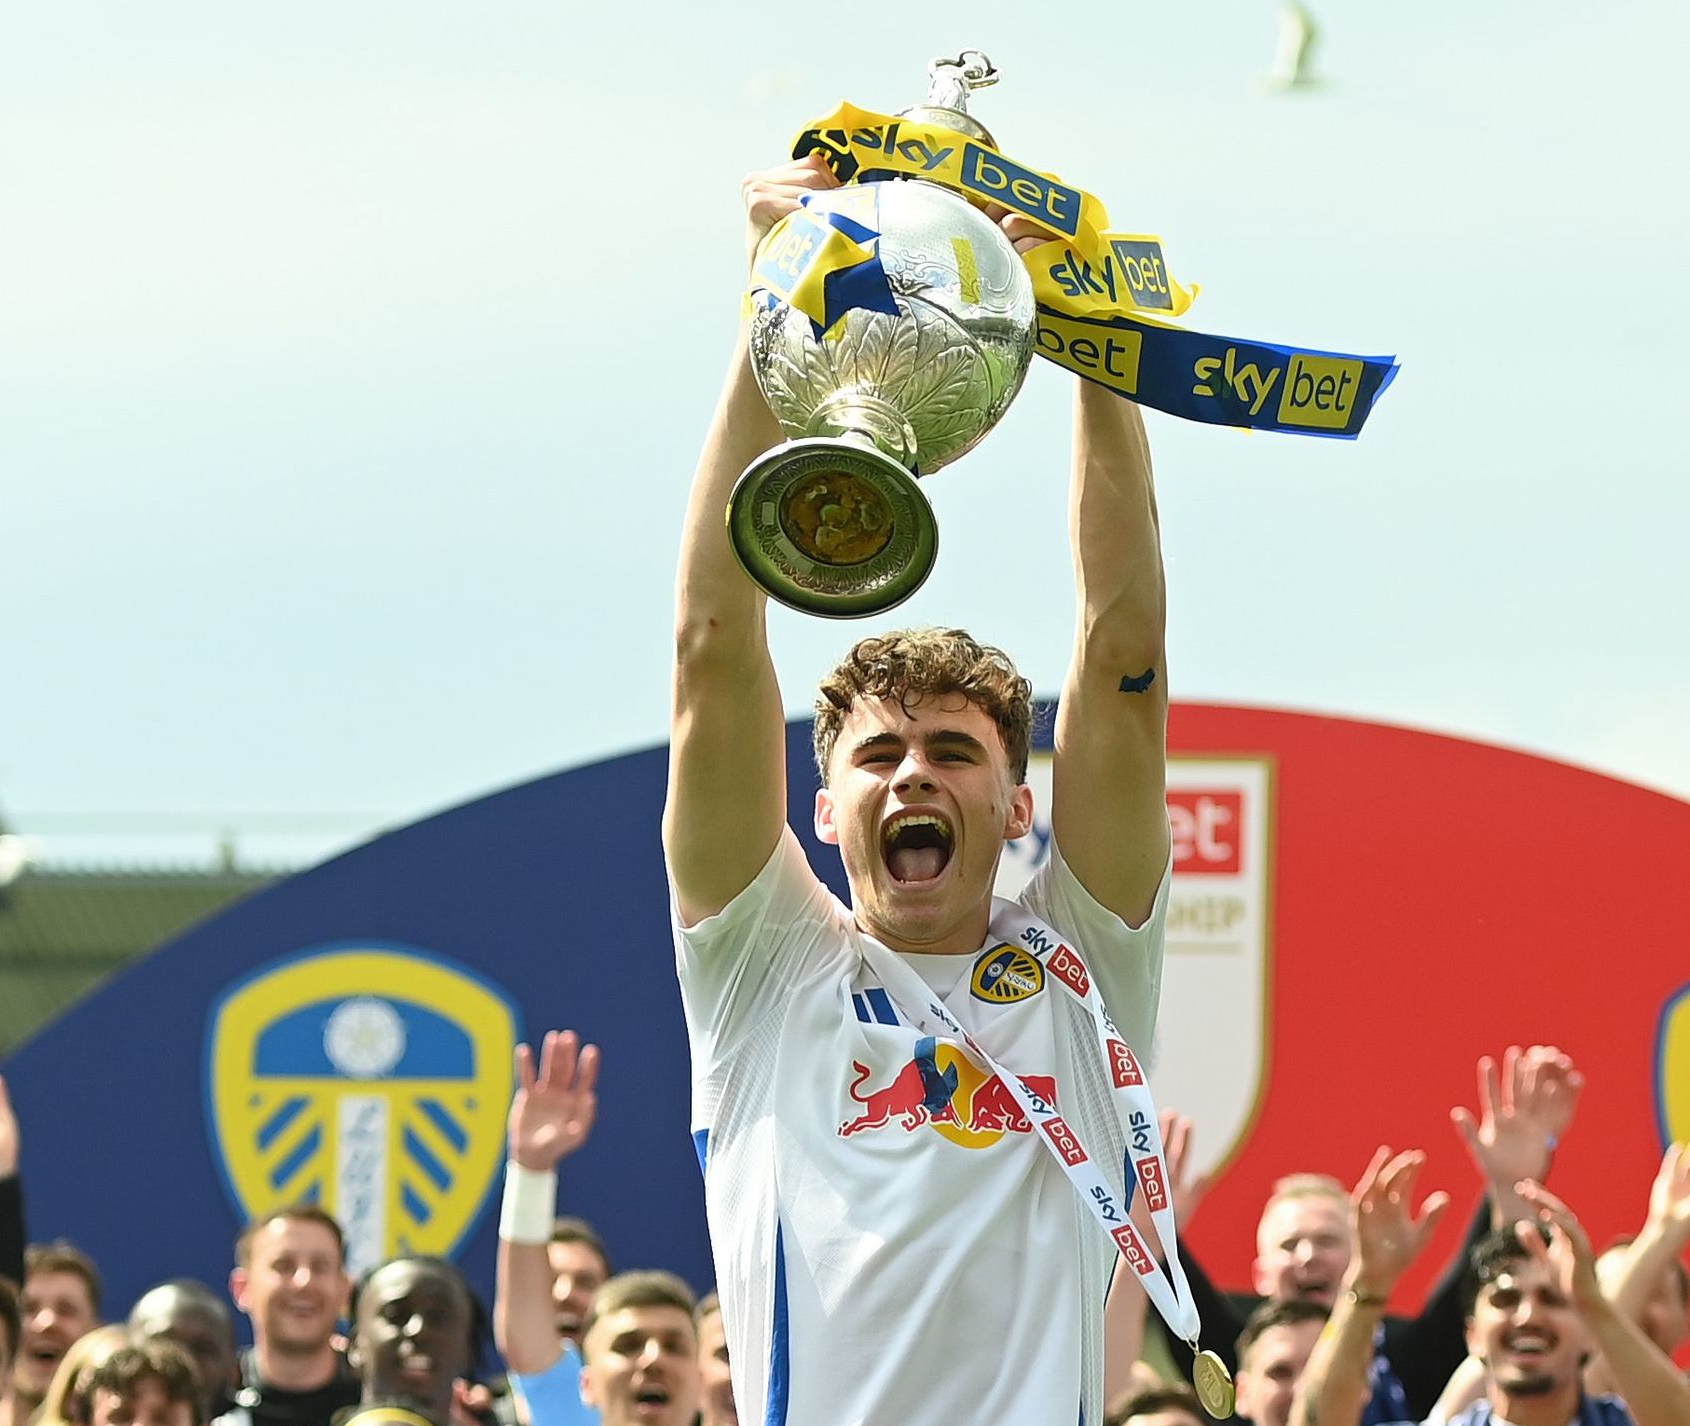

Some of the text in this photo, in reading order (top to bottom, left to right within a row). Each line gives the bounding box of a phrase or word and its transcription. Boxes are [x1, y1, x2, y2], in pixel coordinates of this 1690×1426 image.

[973, 152, 1068, 221] bet
[1122, 245, 1168, 294] bet
[1194, 347, 1280, 415] sky
[1290, 359, 1352, 412] bet
[1167, 796, 1233, 862] et
[1021, 926, 1085, 989] sky bet
[1114, 1042, 1137, 1084] bet
[1048, 1121, 1081, 1161] bet
[1128, 1110, 1164, 1208] sky bet
[1090, 1185, 1148, 1275] sky bet
